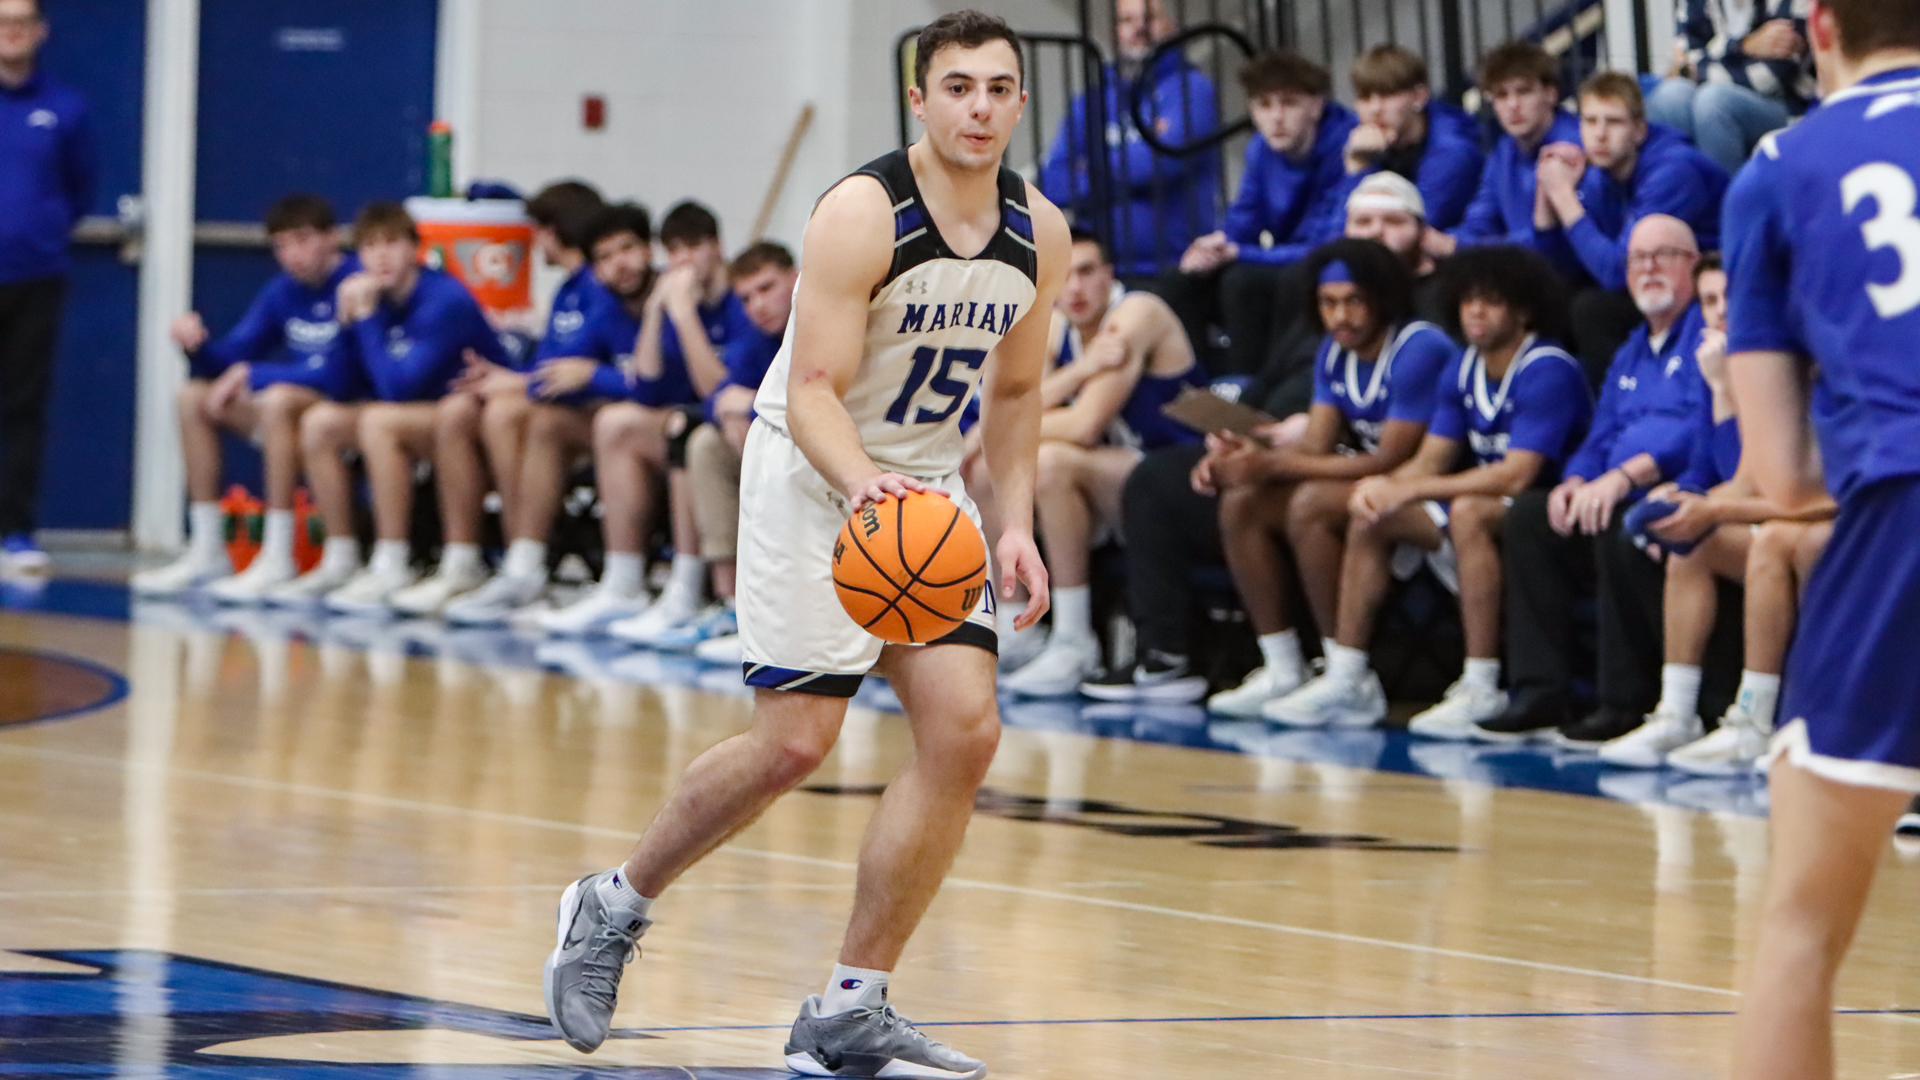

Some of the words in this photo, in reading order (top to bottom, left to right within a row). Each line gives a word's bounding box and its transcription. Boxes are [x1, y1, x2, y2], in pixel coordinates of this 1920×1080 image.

[1840, 161, 1920, 320] 3
[896, 301, 1019, 336] MARIAN
[883, 345, 989, 427] 15
